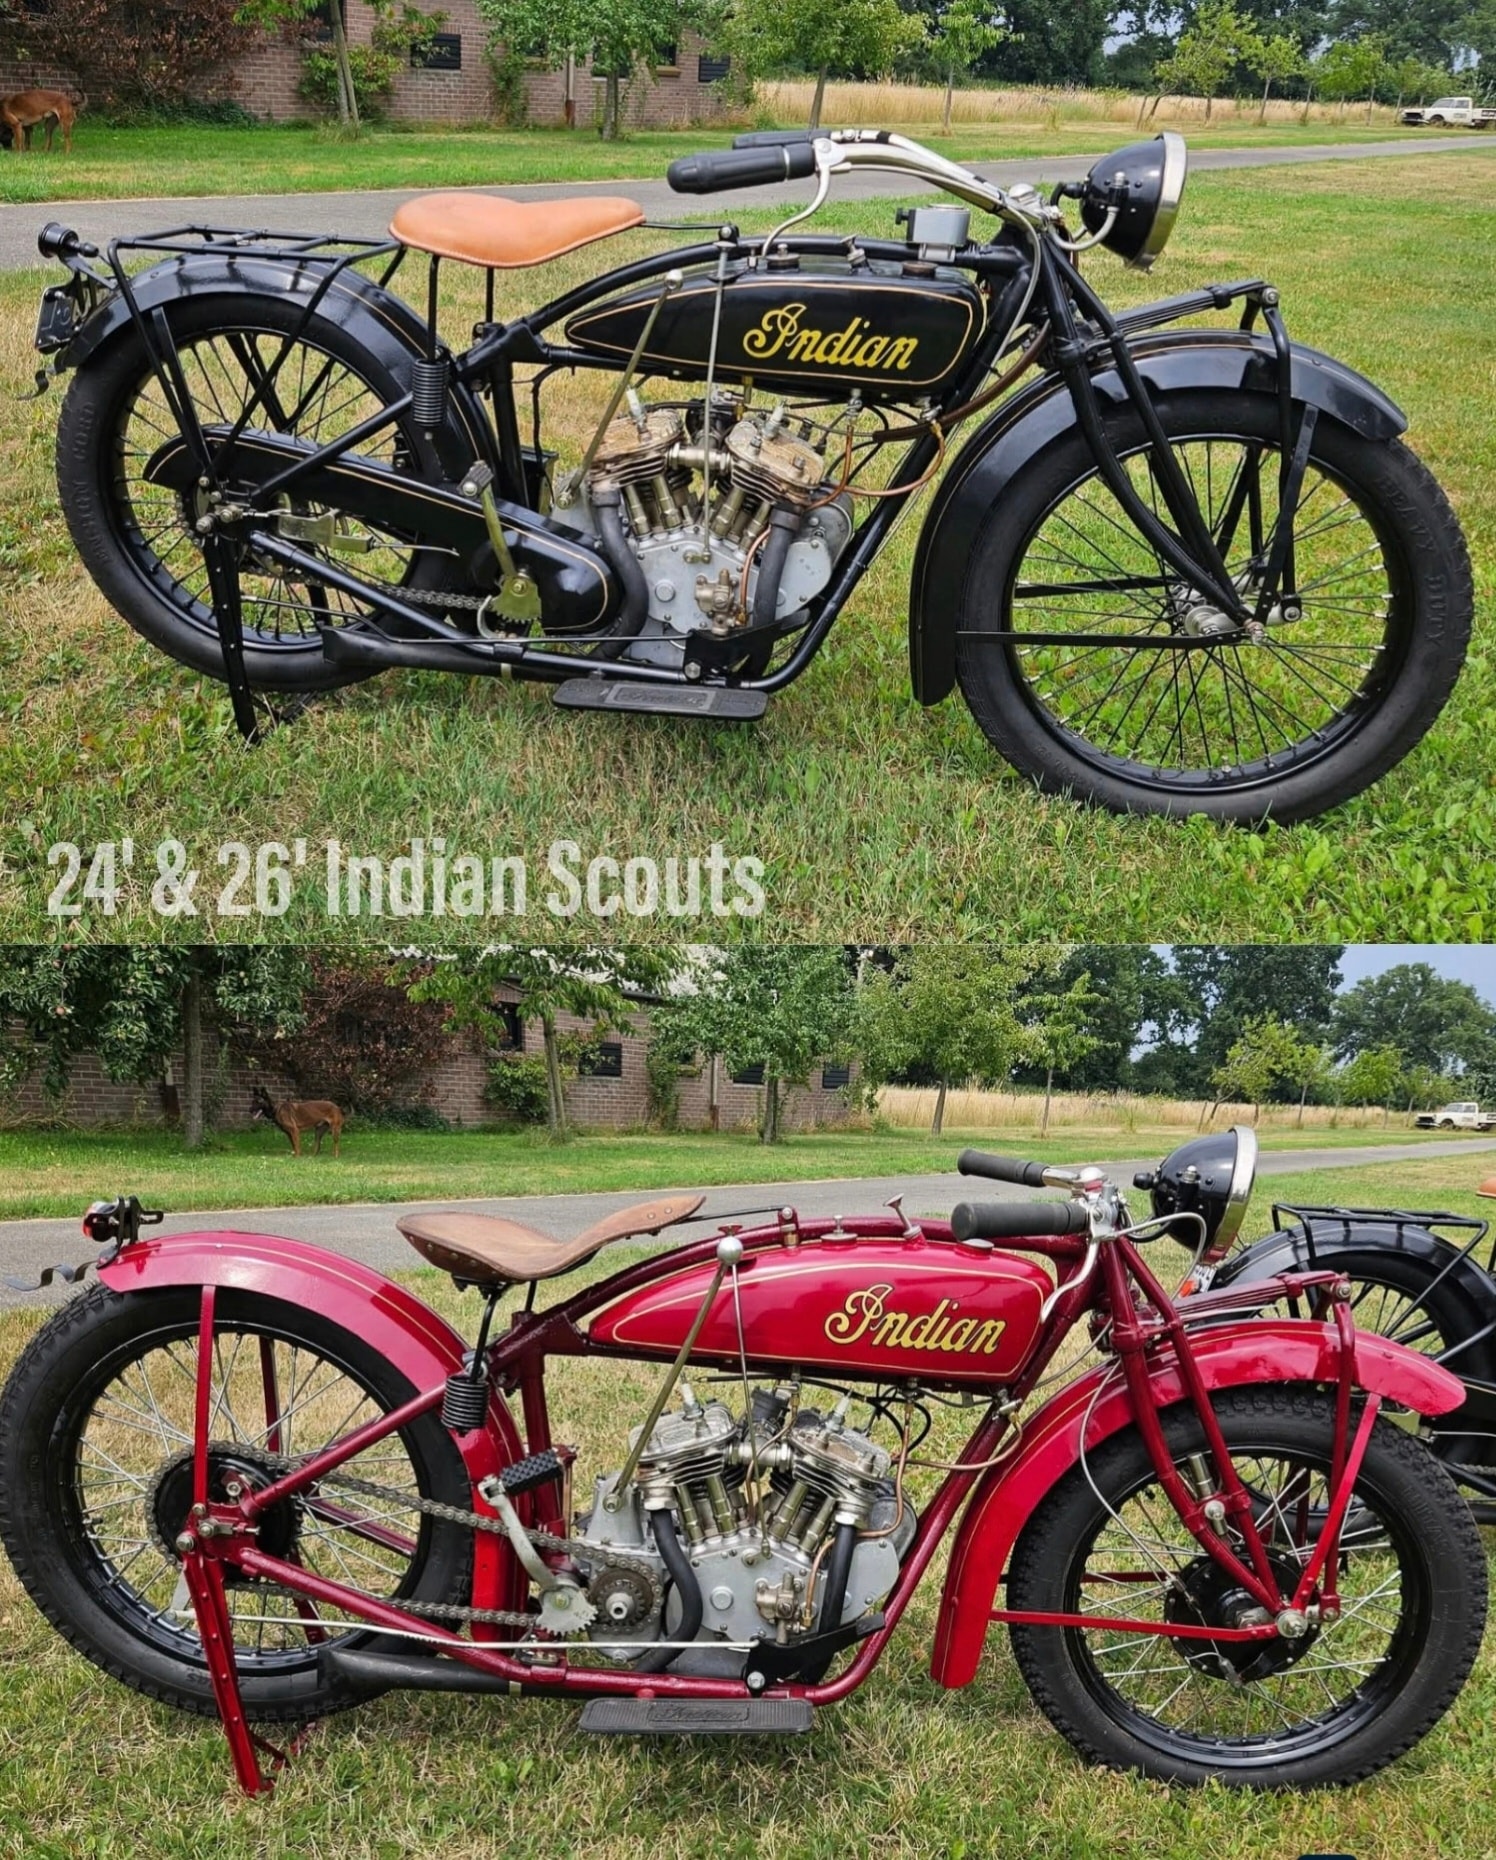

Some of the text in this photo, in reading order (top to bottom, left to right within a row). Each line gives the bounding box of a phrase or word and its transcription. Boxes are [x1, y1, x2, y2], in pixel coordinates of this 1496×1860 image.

[743, 303, 919, 370] Indian
[71, 401, 95, 461] CORD
[1374, 475, 1448, 646] HEAVY DUTY
[824, 1284, 1006, 1354] Indian
